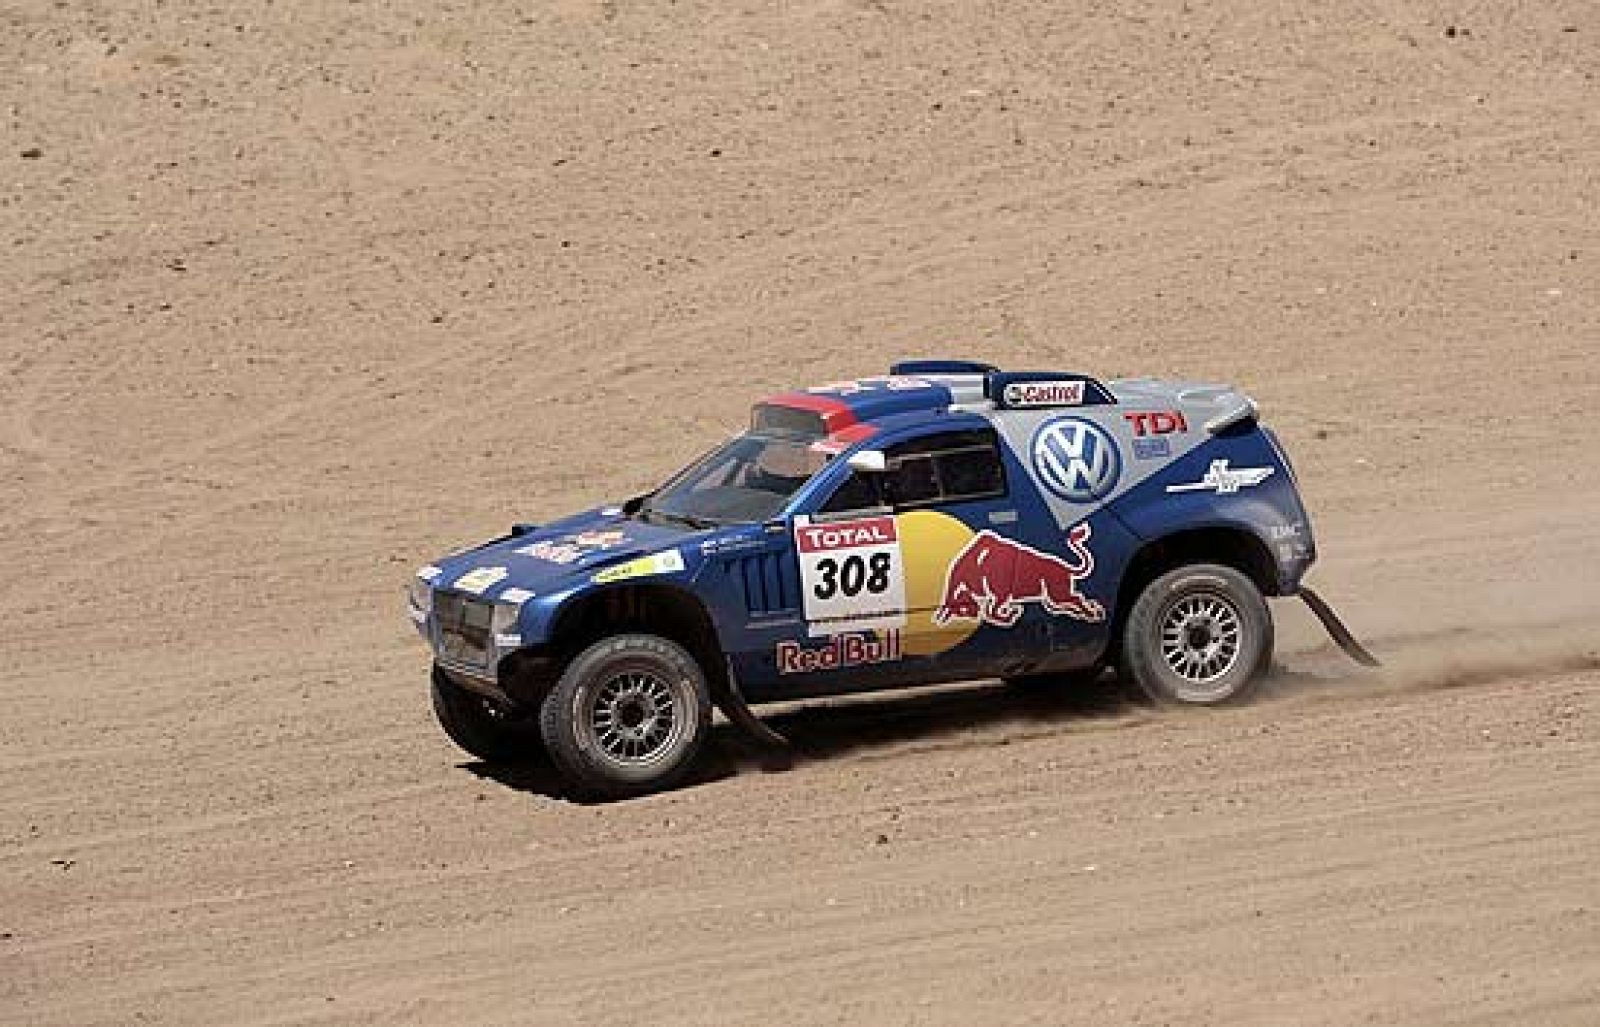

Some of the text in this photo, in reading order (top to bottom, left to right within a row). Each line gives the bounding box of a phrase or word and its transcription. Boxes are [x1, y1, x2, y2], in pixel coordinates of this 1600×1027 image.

[1123, 410, 1188, 437] TDI
[805, 526, 889, 548] TOTAL
[813, 552, 891, 600] 308
